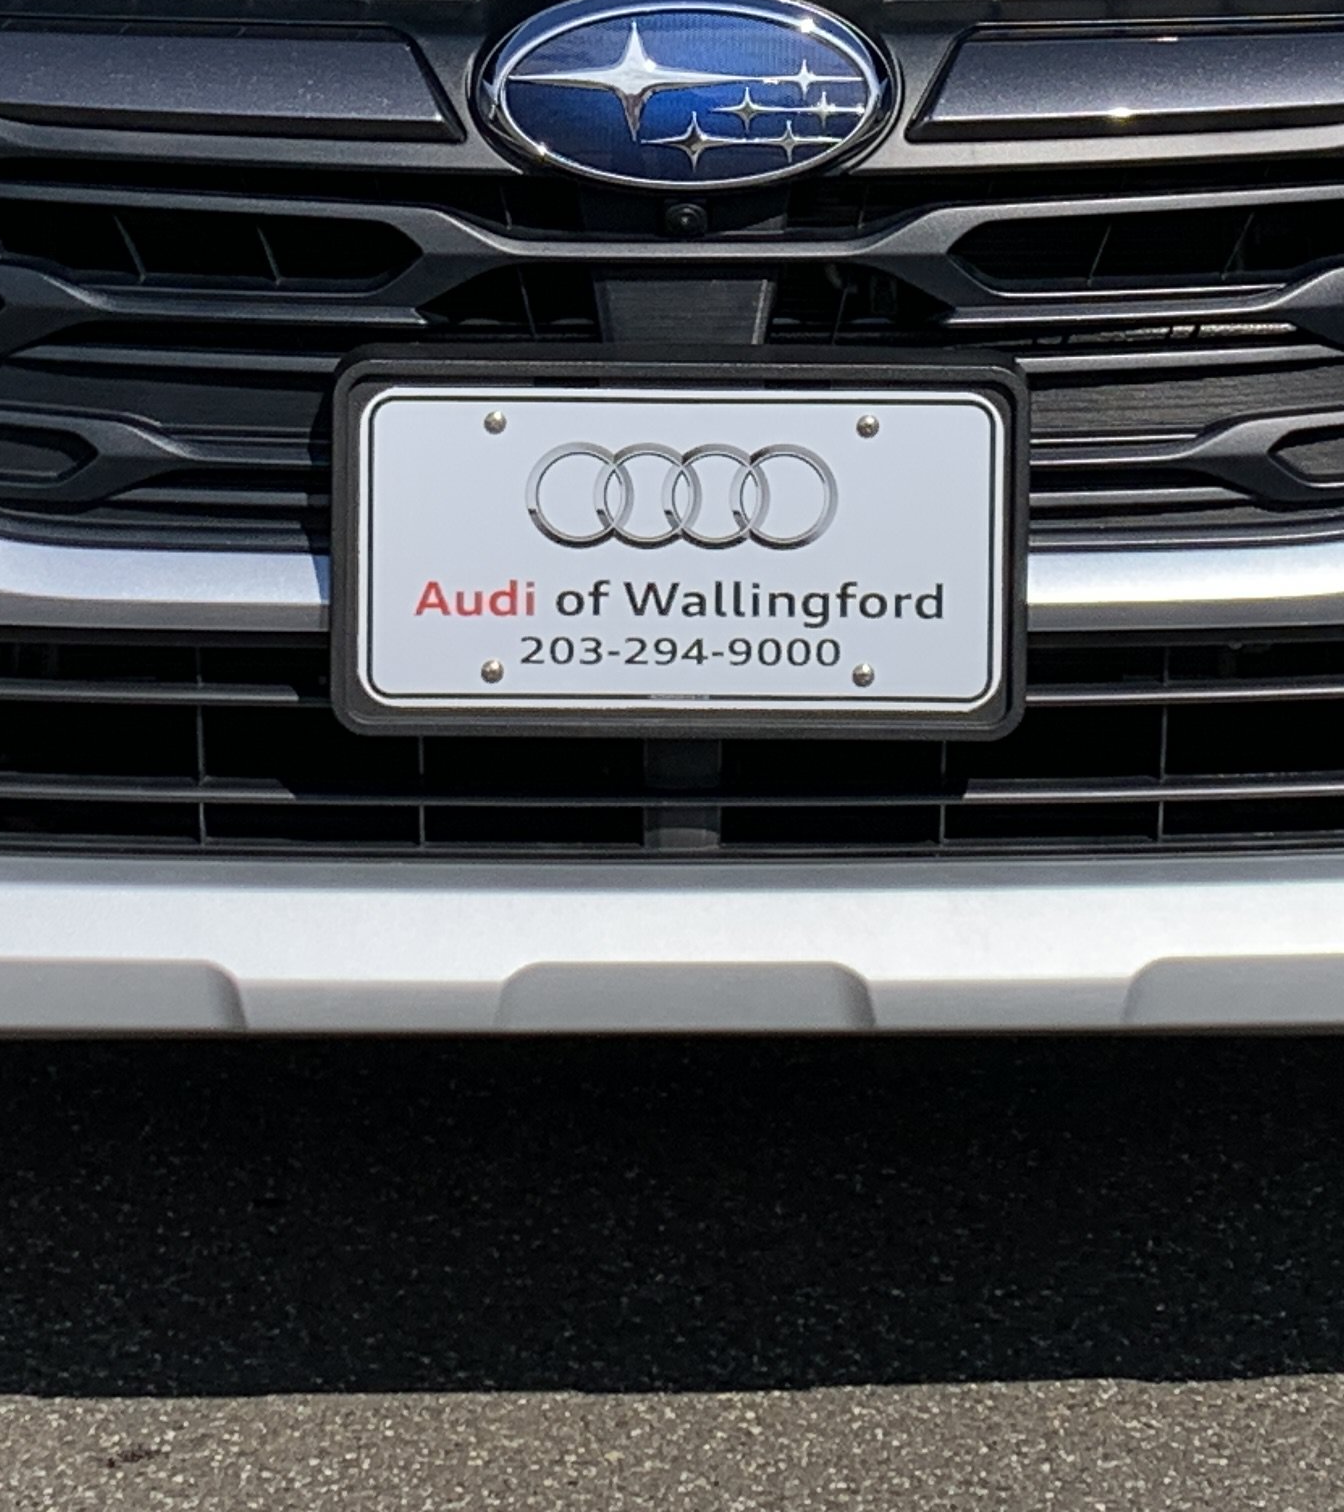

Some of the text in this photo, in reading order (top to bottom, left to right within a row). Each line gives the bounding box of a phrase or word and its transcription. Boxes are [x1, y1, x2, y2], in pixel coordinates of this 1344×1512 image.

[414, 579, 945, 630] Audi of Wallingford
[519, 635, 842, 668] 203-294-9000
